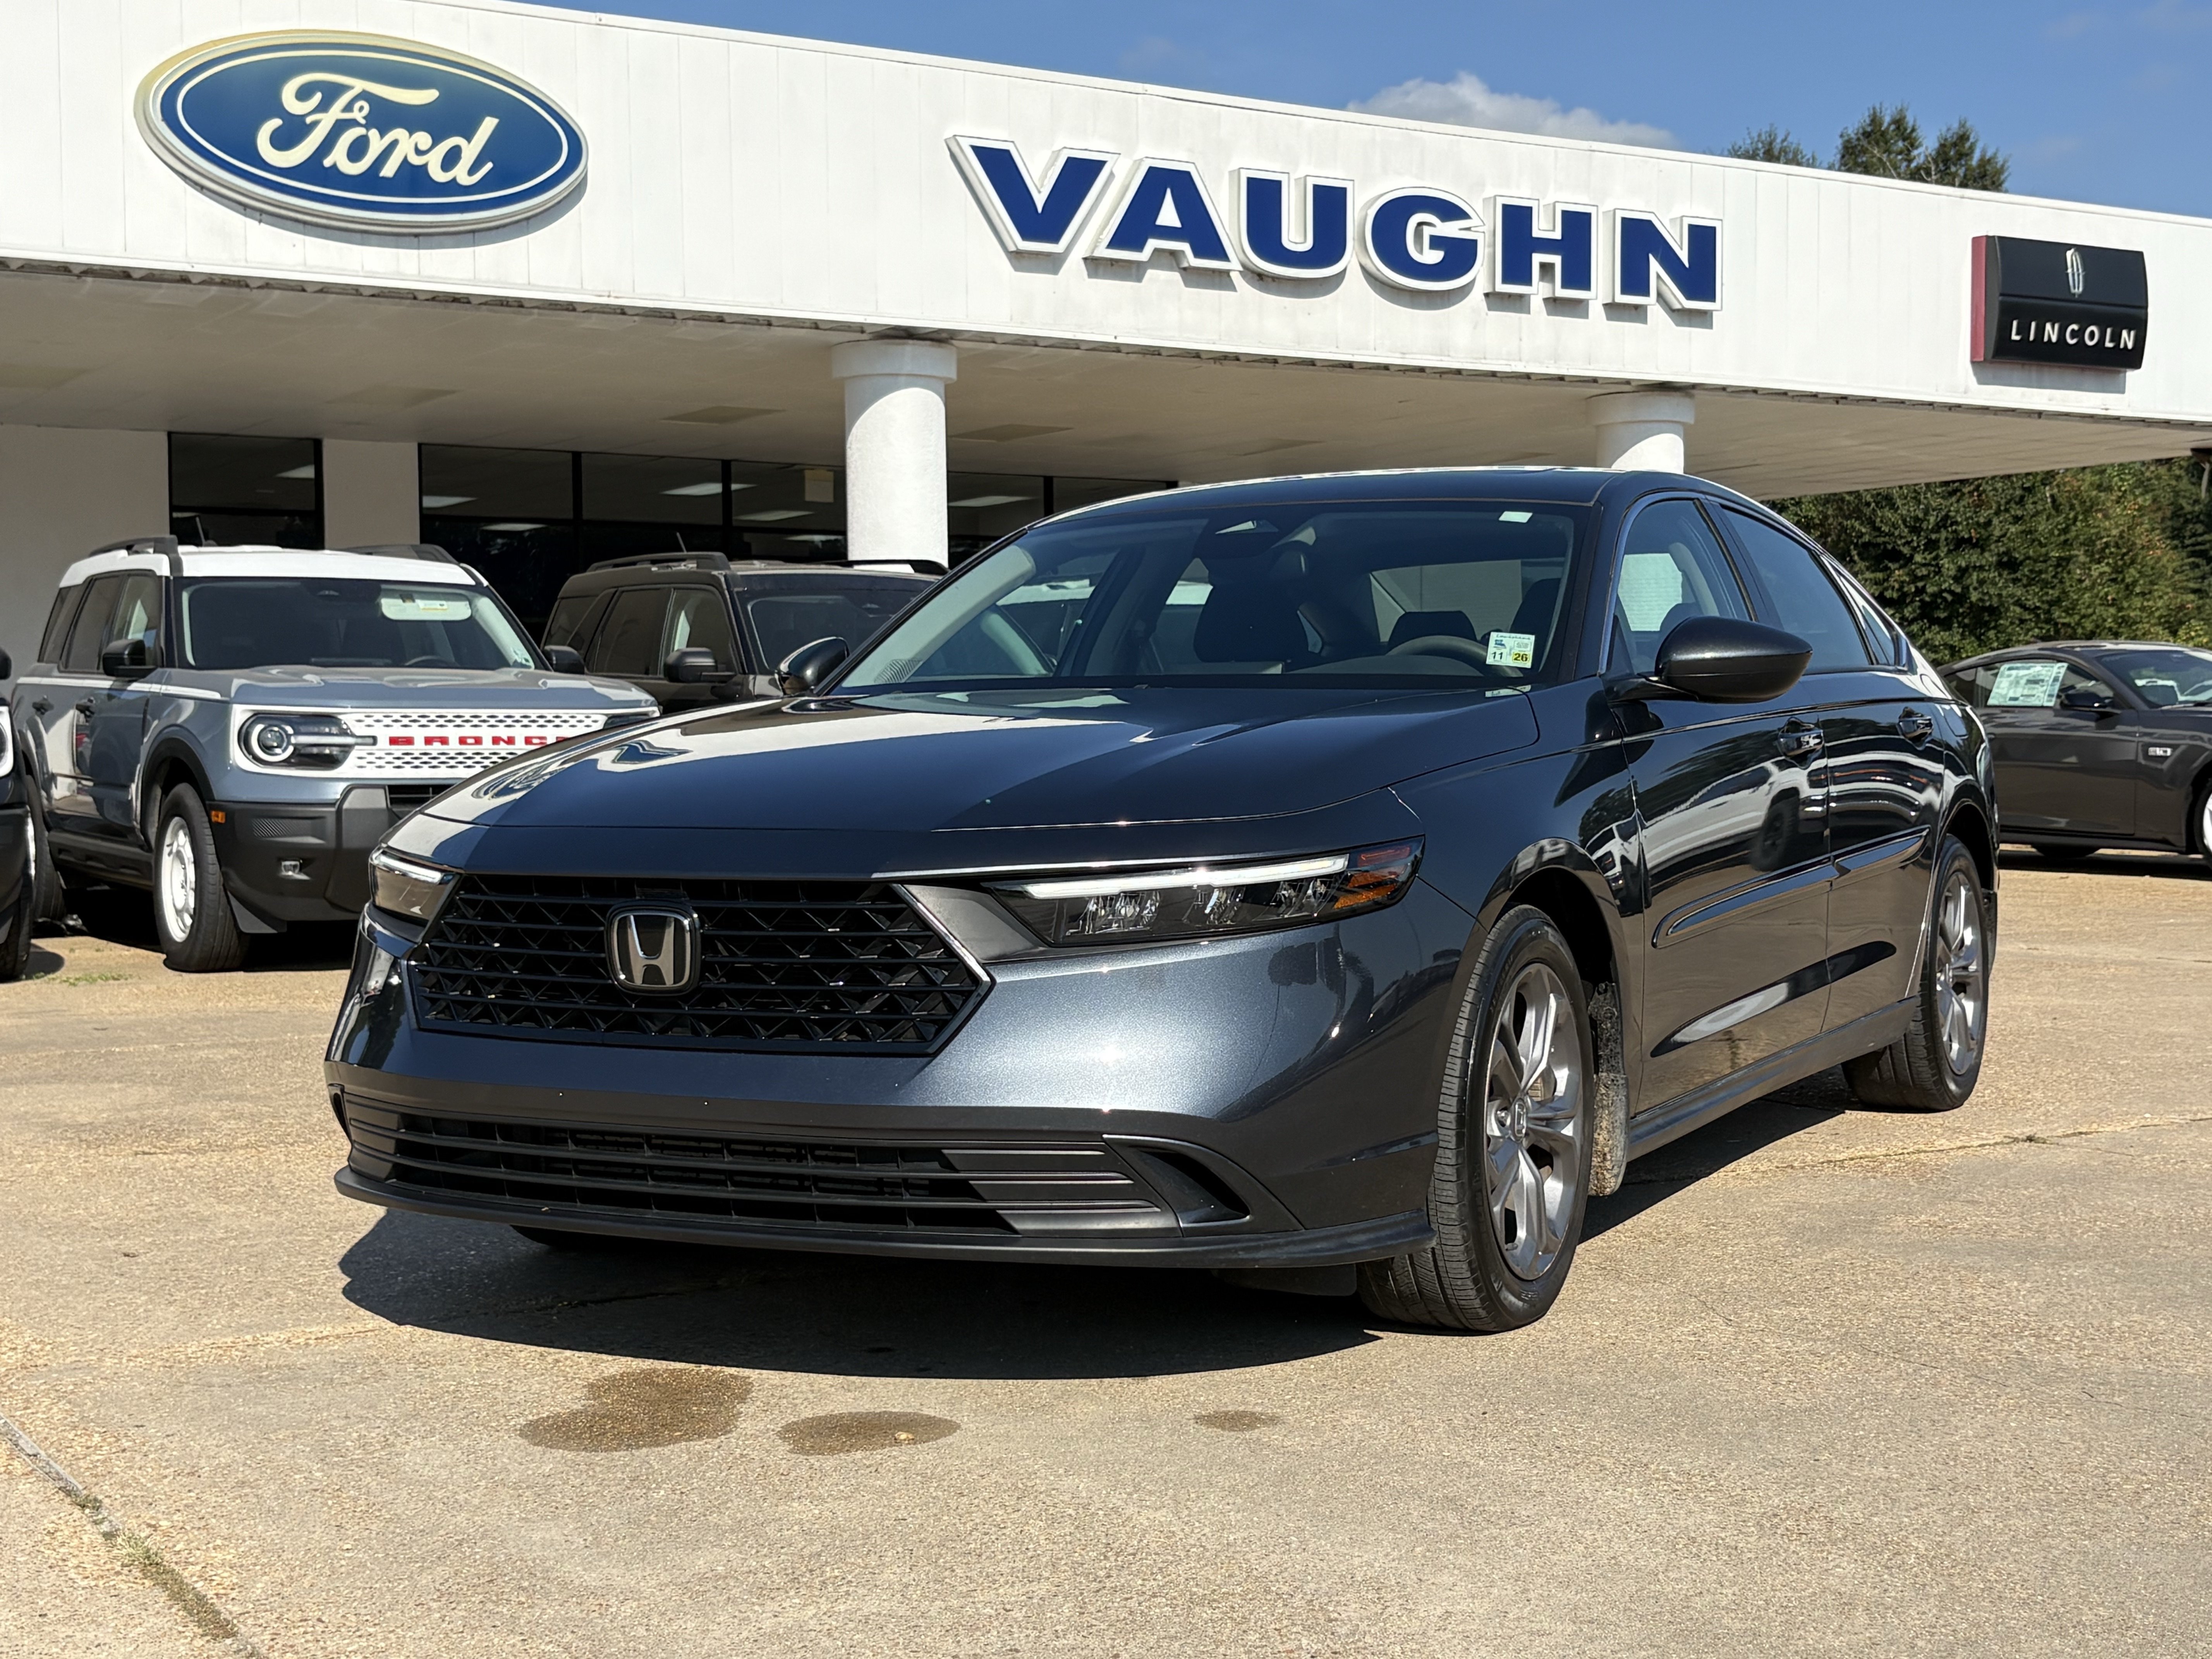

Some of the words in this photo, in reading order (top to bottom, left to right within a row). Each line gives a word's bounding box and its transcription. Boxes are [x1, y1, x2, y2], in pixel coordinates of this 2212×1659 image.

[257, 72, 499, 186] Ford
[966, 141, 1717, 306] VAUGHN
[2011, 319, 2136, 349] LINCOLN
[1491, 651, 1503, 660] 11
[1514, 653, 1528, 661] 26
